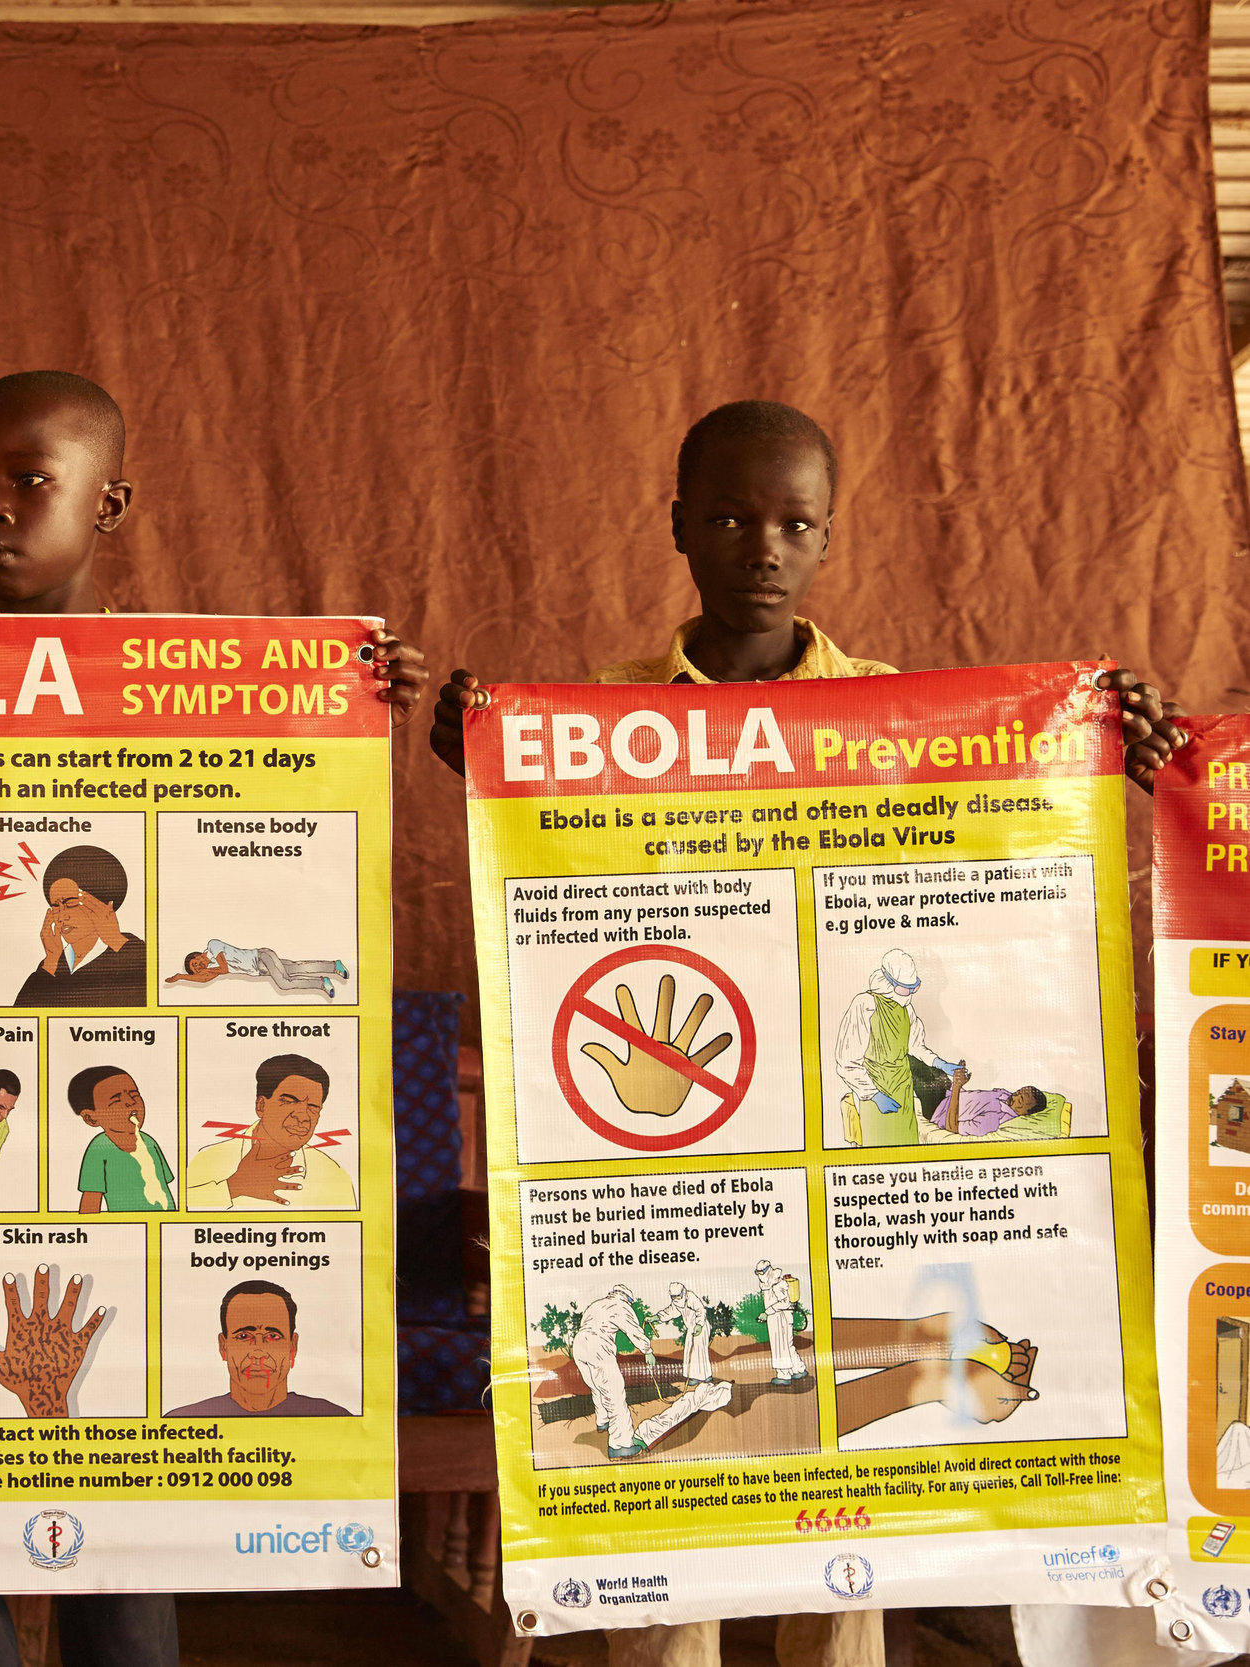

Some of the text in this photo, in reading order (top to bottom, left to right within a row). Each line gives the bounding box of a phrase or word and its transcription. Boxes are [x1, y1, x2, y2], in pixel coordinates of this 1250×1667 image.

[123, 639, 350, 669] SIGNS AND
[121, 684, 350, 715] SYMPTOMS
[502, 708, 794, 780] EBOLA
[813, 719, 1086, 771] Prevention
[11, 754, 50, 766] can
[58, 751, 111, 767] start
[117, 748, 172, 767] from
[180, 749, 191, 766] 2
[199, 751, 222, 767] to
[229, 749, 253, 766] 21
[263, 748, 315, 772] days
[18, 784, 44, 797] an
[53, 778, 146, 797] infected
[154, 784, 240, 802] person.
[540, 794, 1052, 829] Ebola is a severe and often deadly disease
[0, 817, 90, 831] Headache
[198, 818, 316, 836] Intense body
[212, 841, 301, 856] weakness
[645, 826, 954, 856] caused by the Ebola Virus
[514, 878, 751, 900] Avoid direct contact with body
[514, 900, 770, 922] fluids from any person suspected
[516, 925, 690, 944] or infected with Ebola.
[1213, 953, 1230, 968] IF
[70, 1026, 154, 1044] Vomiting
[227, 1022, 329, 1036] Sore throat
[1210, 1026, 1246, 1043] Stay
[3, 1228, 86, 1243] Skin rash
[195, 1227, 325, 1246] Bleeding from
[191, 1252, 329, 1270] body openings
[39, 1425, 79, 1440] with
[85, 1425, 136, 1439] those
[142, 1424, 223, 1439] infected.
[29, 1451, 47, 1464] to
[53, 1449, 83, 1464] the
[89, 1450, 158, 1464] nearest
[164, 1448, 222, 1463] health
[228, 1447, 295, 1466] facility.
[8, 1473, 73, 1487] hotline
[80, 1472, 152, 1486] number
[167, 1472, 212, 1486] 0912
[219, 1472, 252, 1486] 000
[258, 1472, 291, 1486] 098
[795, 1506, 872, 1533] 6666
[235, 1523, 332, 1554] unicef
[1043, 1546, 1097, 1565] unicef
[596, 1575, 667, 1589] World Health
[1047, 1567, 1125, 1582] for every child
[599, 1592, 668, 1605] Organization
